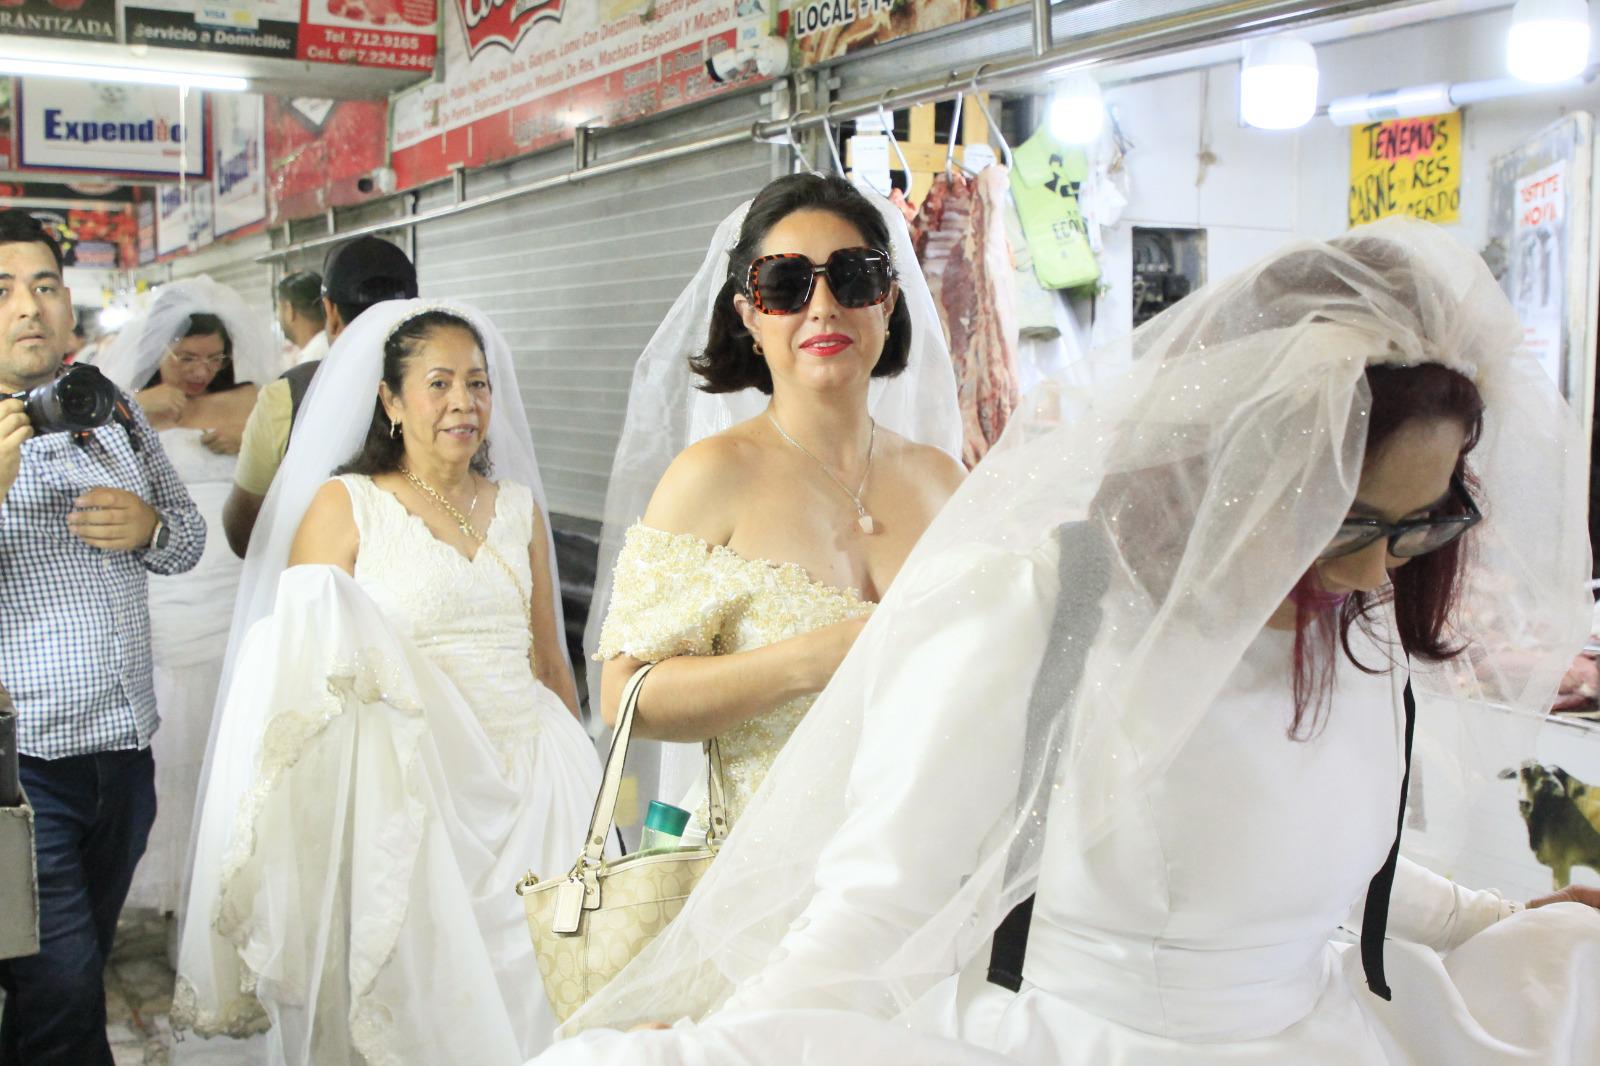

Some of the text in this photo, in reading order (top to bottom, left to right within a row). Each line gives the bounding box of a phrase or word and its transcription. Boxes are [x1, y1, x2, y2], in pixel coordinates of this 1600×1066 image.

[204, 9, 226, 19] VISA
[795, 0, 855, 36] LOCAL
[133, 21, 291, 50] Servicio a Domicilio:
[44, 109, 188, 143] Expendio
[1362, 119, 1449, 160] TENEMOS
[1348, 156, 1450, 228] CARNE RES
